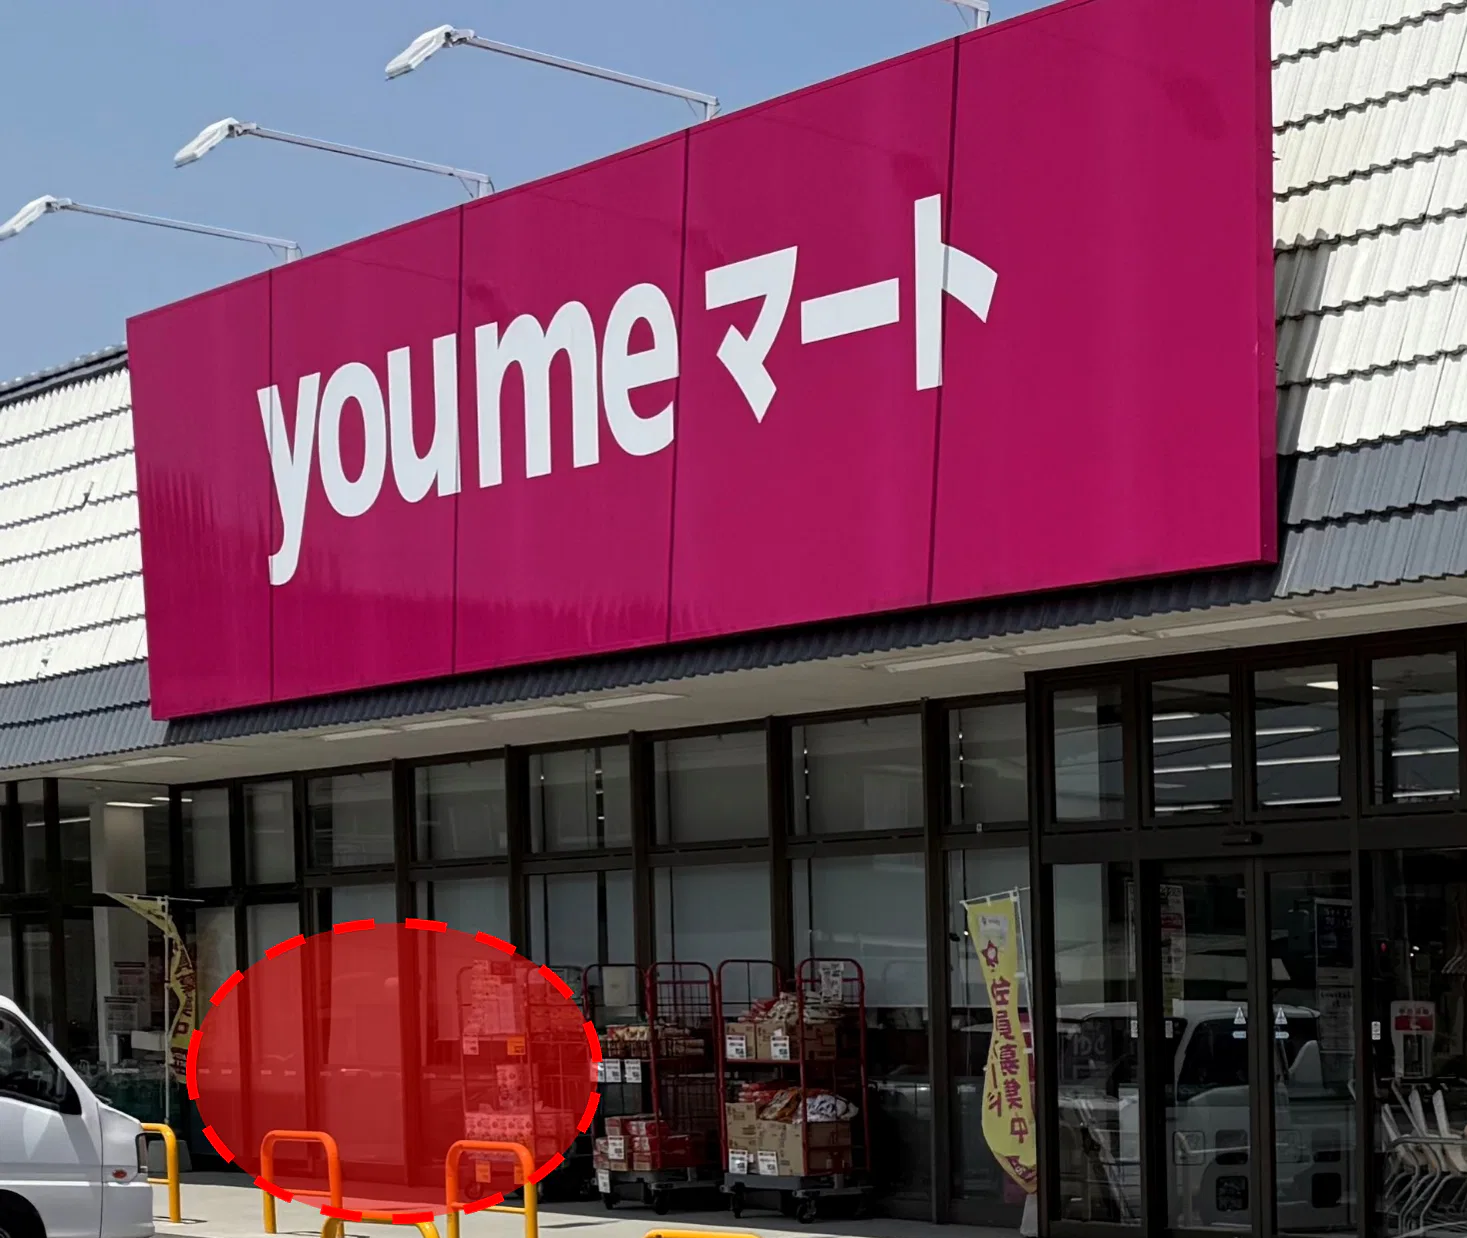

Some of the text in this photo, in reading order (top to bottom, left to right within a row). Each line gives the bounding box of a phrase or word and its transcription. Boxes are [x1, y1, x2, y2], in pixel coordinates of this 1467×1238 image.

[257, 194, 998, 587] youme マート
